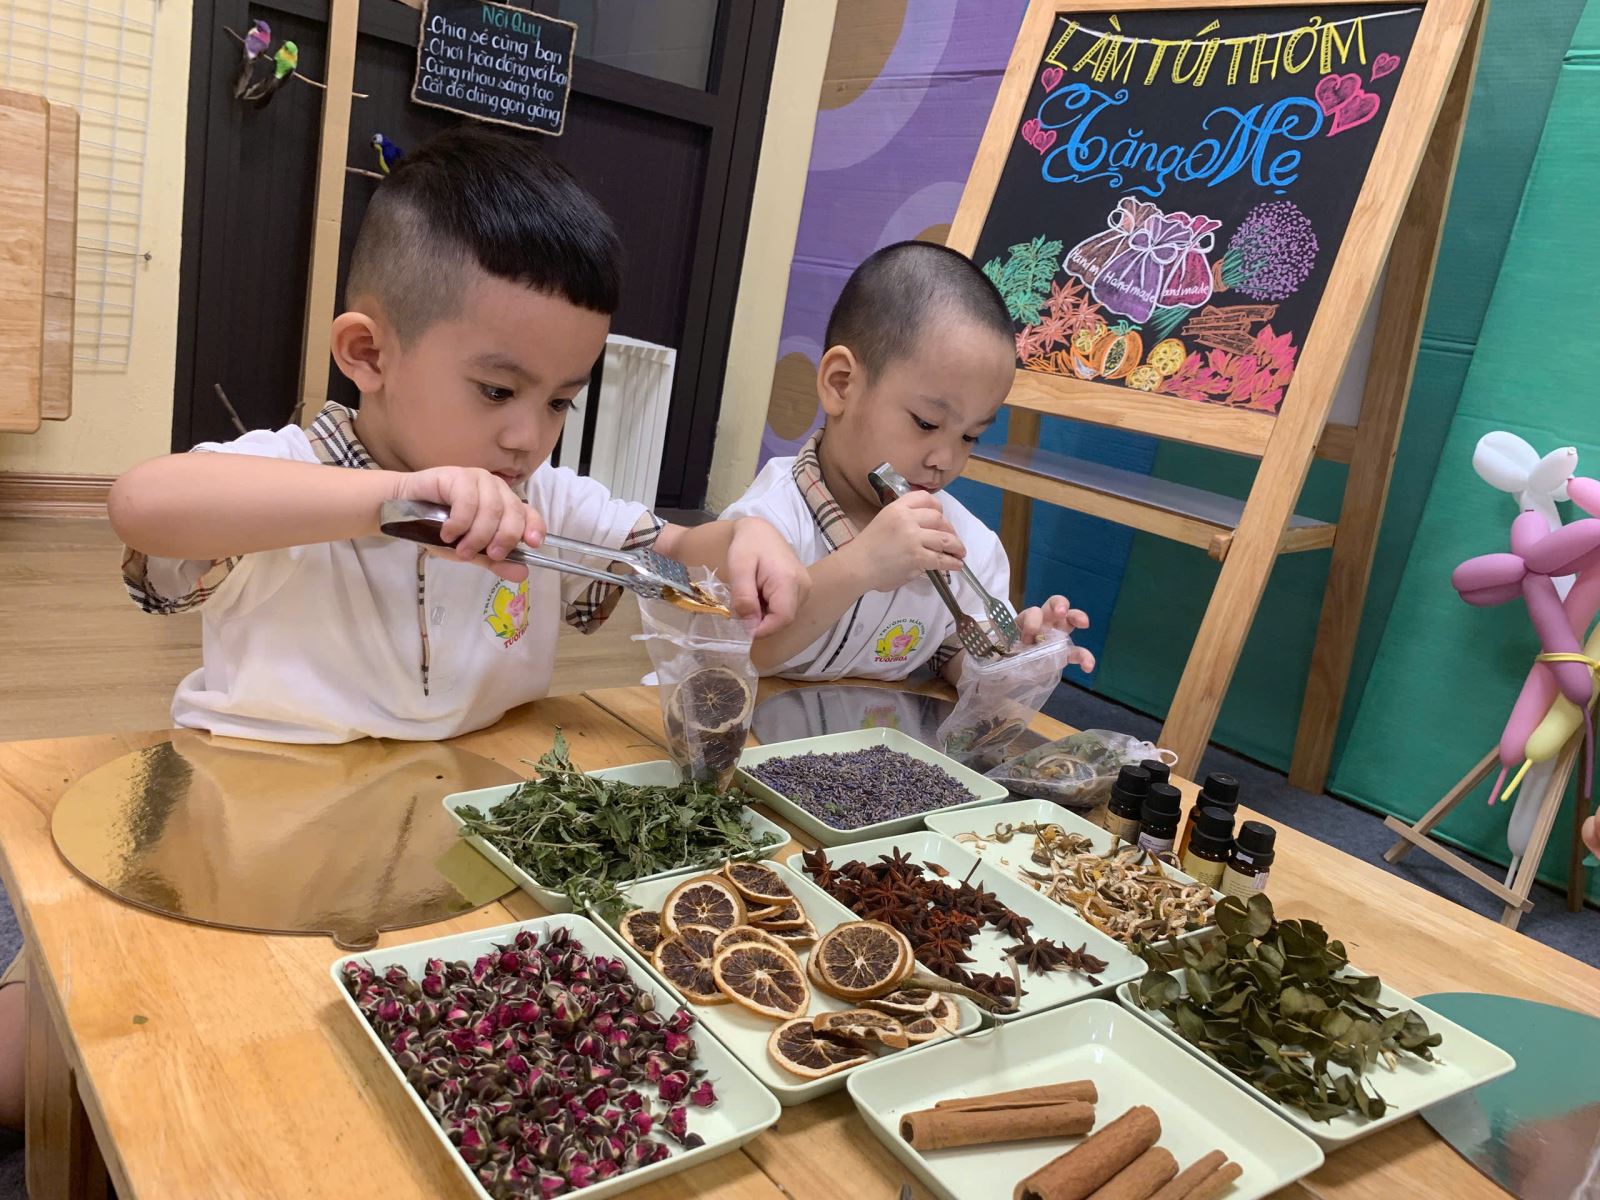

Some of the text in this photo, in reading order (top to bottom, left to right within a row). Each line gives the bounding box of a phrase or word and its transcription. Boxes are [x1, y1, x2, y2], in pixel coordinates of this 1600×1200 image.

[481, 5, 542, 41] Nội Quy
[467, 45, 494, 68] hòa
[495, 54, 529, 82] đồng
[491, 34, 529, 61] cùng
[535, 40, 563, 65] bạn
[1045, 15, 1367, 87] LÀM TÚI THƠM
[445, 80, 466, 100] đồ
[466, 86, 498, 112] dùng
[500, 98, 525, 116] gọn
[461, 66, 496, 88] nhau
[497, 76, 530, 101] sáng
[532, 82, 555, 103] tạo
[1037, 82, 1325, 198] Tặng Mẹ
[1103, 271, 1157, 303] Handmade
